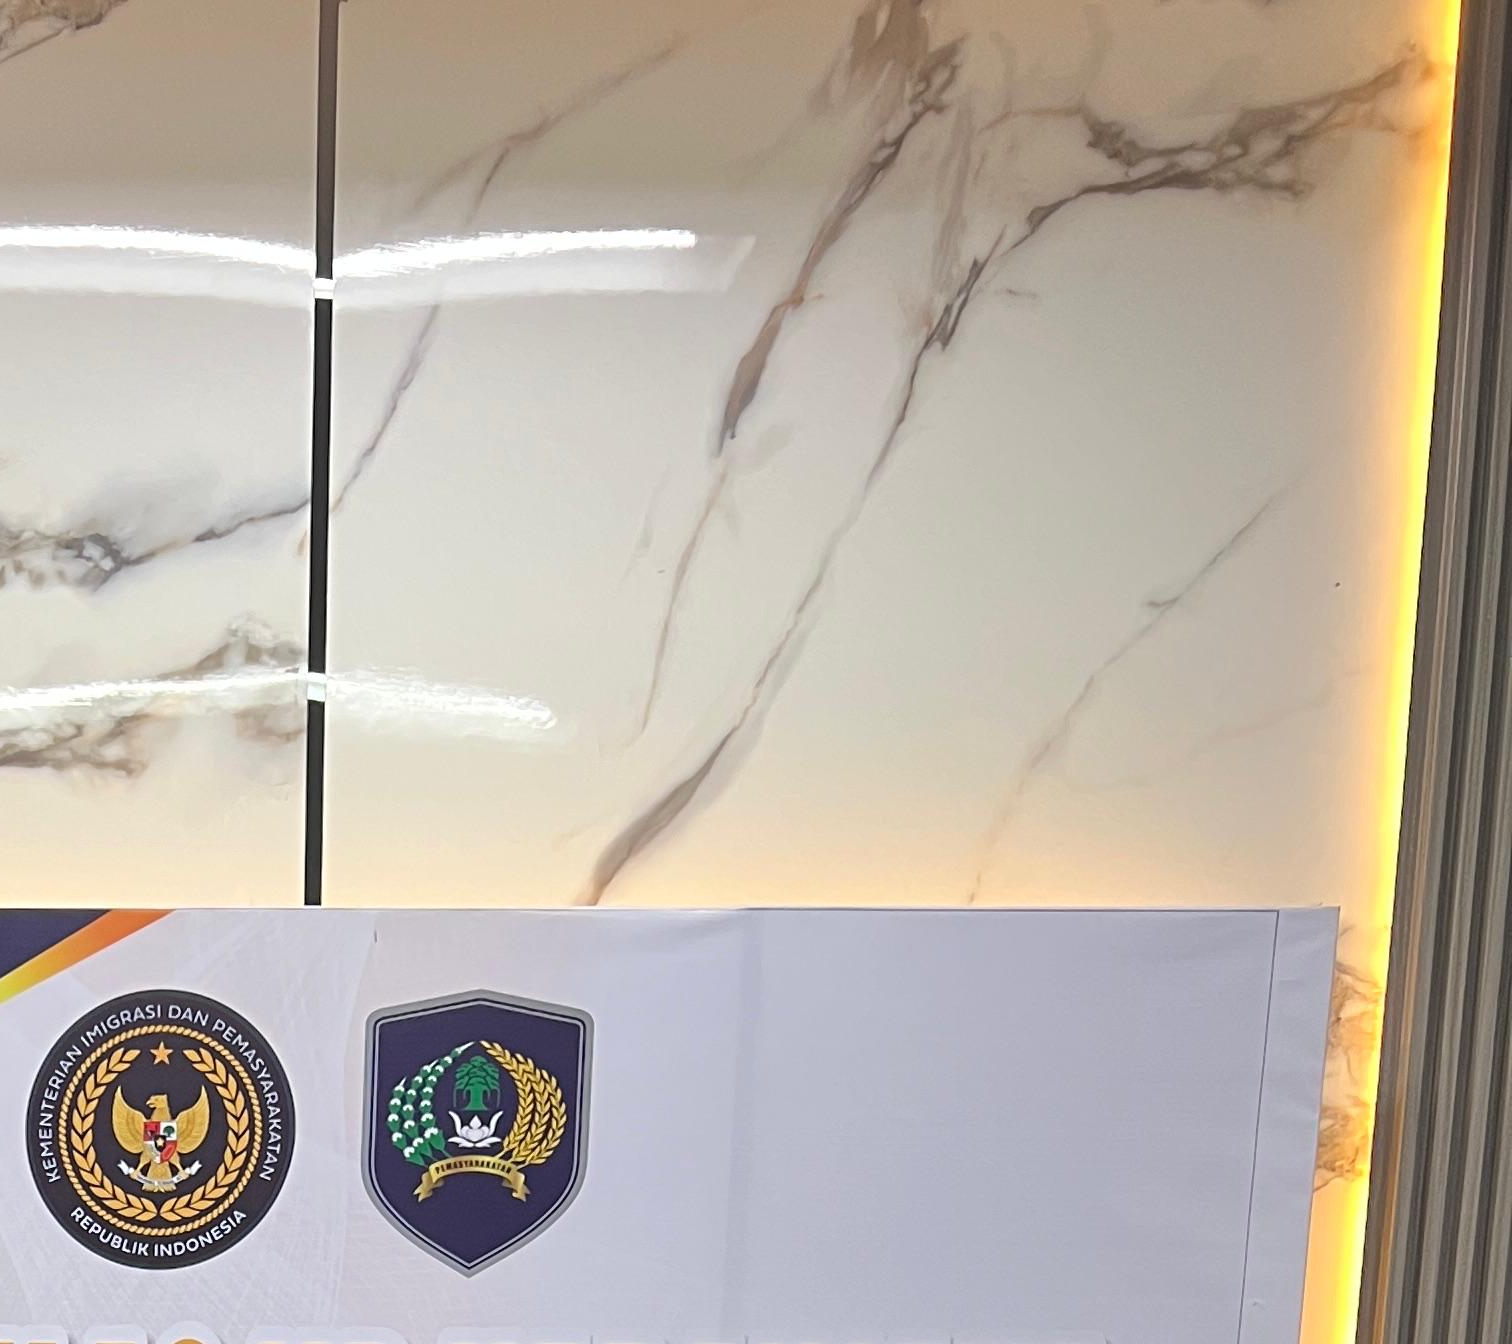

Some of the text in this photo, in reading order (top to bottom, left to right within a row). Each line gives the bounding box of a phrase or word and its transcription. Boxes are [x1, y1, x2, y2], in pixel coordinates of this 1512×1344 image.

[37, 1003, 281, 1184] KEMENTERIAN IMIGRASI DAN PEMASYARAKATAN
[70, 1206, 247, 1258] REPUBLIK INDONESIA
